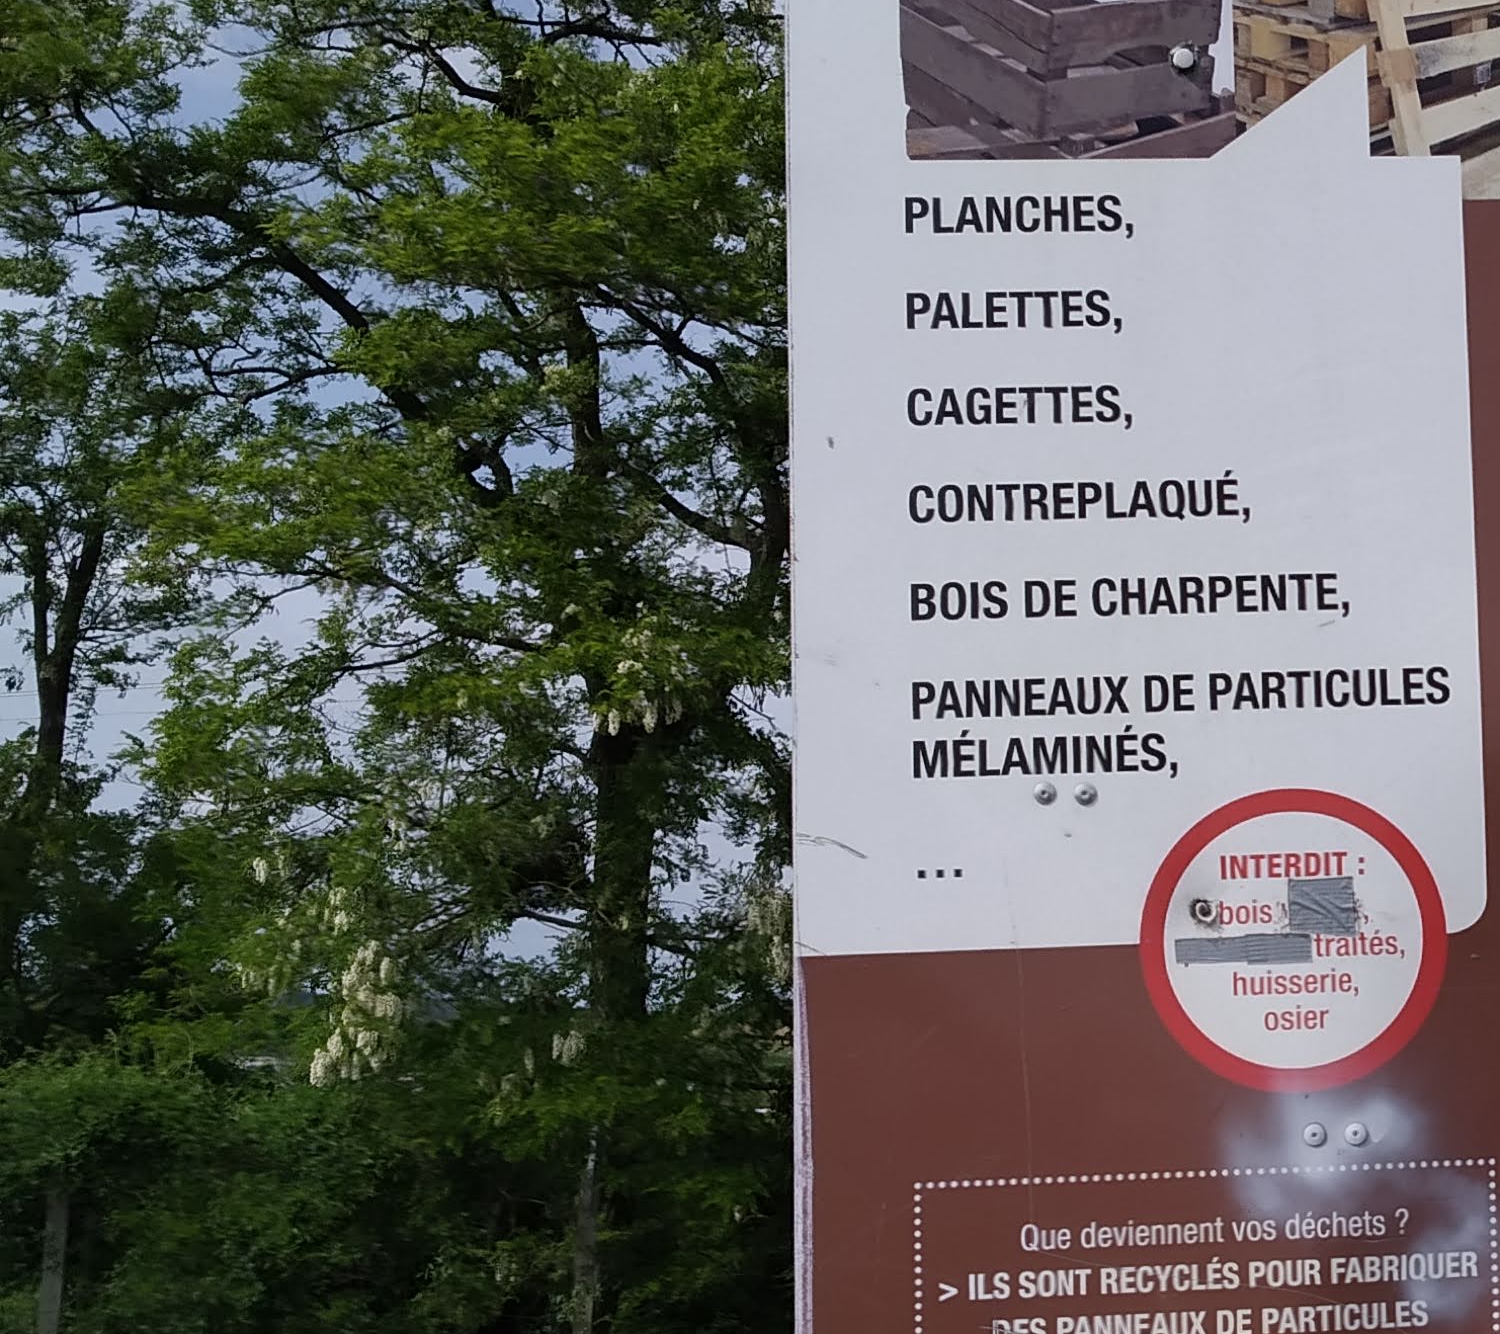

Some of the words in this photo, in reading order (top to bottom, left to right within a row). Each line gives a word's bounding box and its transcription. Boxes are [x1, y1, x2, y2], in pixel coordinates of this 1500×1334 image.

[905, 195, 1133, 238] PLANCHES,
[907, 290, 1121, 333] PALETTES,
[908, 385, 1132, 429] CAGETTES,
[909, 470, 1250, 523] CONTREPLAQUÉ,
[911, 581, 1008, 620] BOIS
[1025, 580, 1077, 618] DE
[1092, 574, 1349, 617] CHARPENTE,
[912, 676, 1129, 719] PANNEAUX
[1144, 674, 1194, 712] DE
[1209, 667, 1449, 710] PARTICULES
[913, 725, 1177, 778] MÉLAMINÉS,
[1220, 852, 1347, 879] INTERDIT
[1218, 900, 1272, 925] bois
[1315, 929, 1405, 958] traités,
[1233, 968, 1358, 996] huisserie,
[1265, 1005, 1329, 1030] osier
[1021, 1224, 1070, 1251] Que
[1081, 1217, 1224, 1248] deviennent
[1232, 1220, 1276, 1241] vos
[1285, 1211, 1385, 1239] déchets
[969, 1272, 1010, 1300] ILS
[1019, 1269, 1091, 1298] SONT
[1101, 1257, 1239, 1294] RECYCLÉS
[1249, 1260, 1321, 1287] POUR
[1330, 1251, 1479, 1287] FABRIQUER
